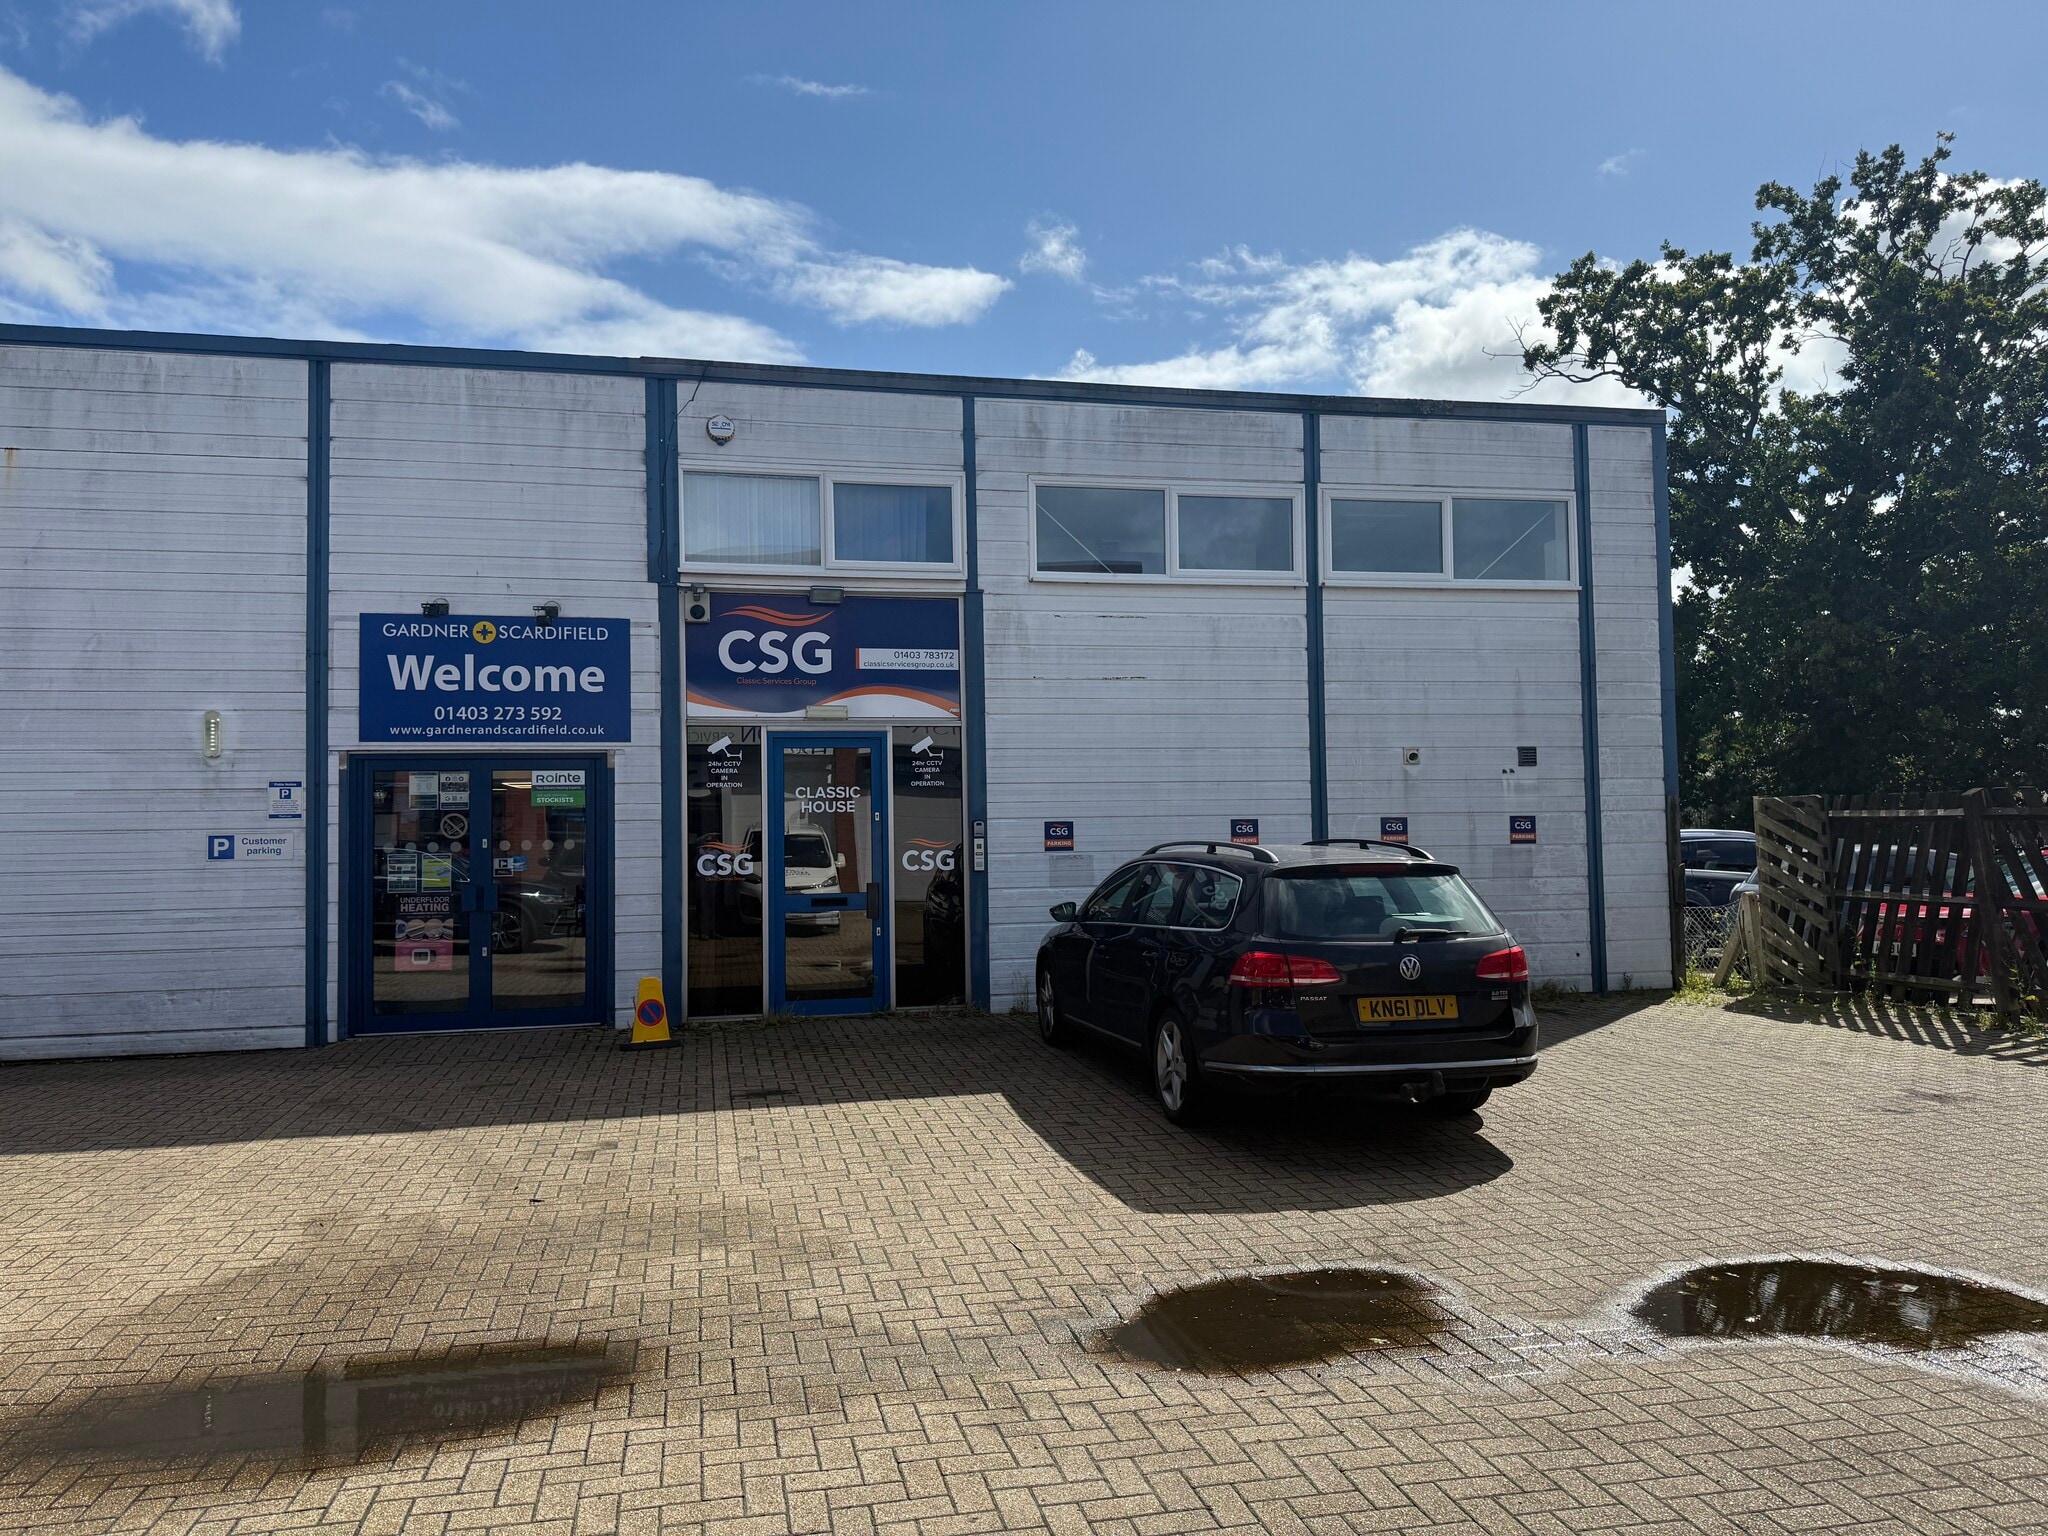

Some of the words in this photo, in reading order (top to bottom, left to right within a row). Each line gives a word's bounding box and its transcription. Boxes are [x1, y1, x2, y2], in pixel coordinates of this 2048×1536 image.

[382, 622, 469, 638] GARDNER
[499, 625, 609, 641] SCARDIFIELD
[718, 629, 833, 675] CSG
[893, 651, 921, 660] 01403
[923, 651, 955, 660] 783172
[863, 660, 955, 669] classicservicesgroup.co.uk
[387, 654, 605, 693] Welcome
[736, 677, 762, 685] Classic
[762, 677, 793, 686] Services
[793, 677, 817, 687] Group
[434, 706, 488, 721] 01403
[493, 706, 525, 721] 273
[531, 706, 562, 721] 592
[389, 724, 605, 737] www.gardnerandscardifield.co.uk
[795, 787, 861, 799] CLASSIC
[801, 801, 856, 813] HOUSE
[1049, 826, 1069, 836] CSG
[1235, 824, 1254, 833] CSG
[1385, 823, 1403, 831] CSG
[1514, 821, 1532, 829] CSG
[213, 838, 230, 857] P
[241, 837, 287, 846] Customer
[246, 846, 282, 857] parking
[696, 853, 754, 877] CSG
[901, 849, 955, 871] CSG
[400, 903, 449, 913] HEATING
[1369, 999, 1411, 1018] KN61
[1416, 998, 1447, 1017] DLV
